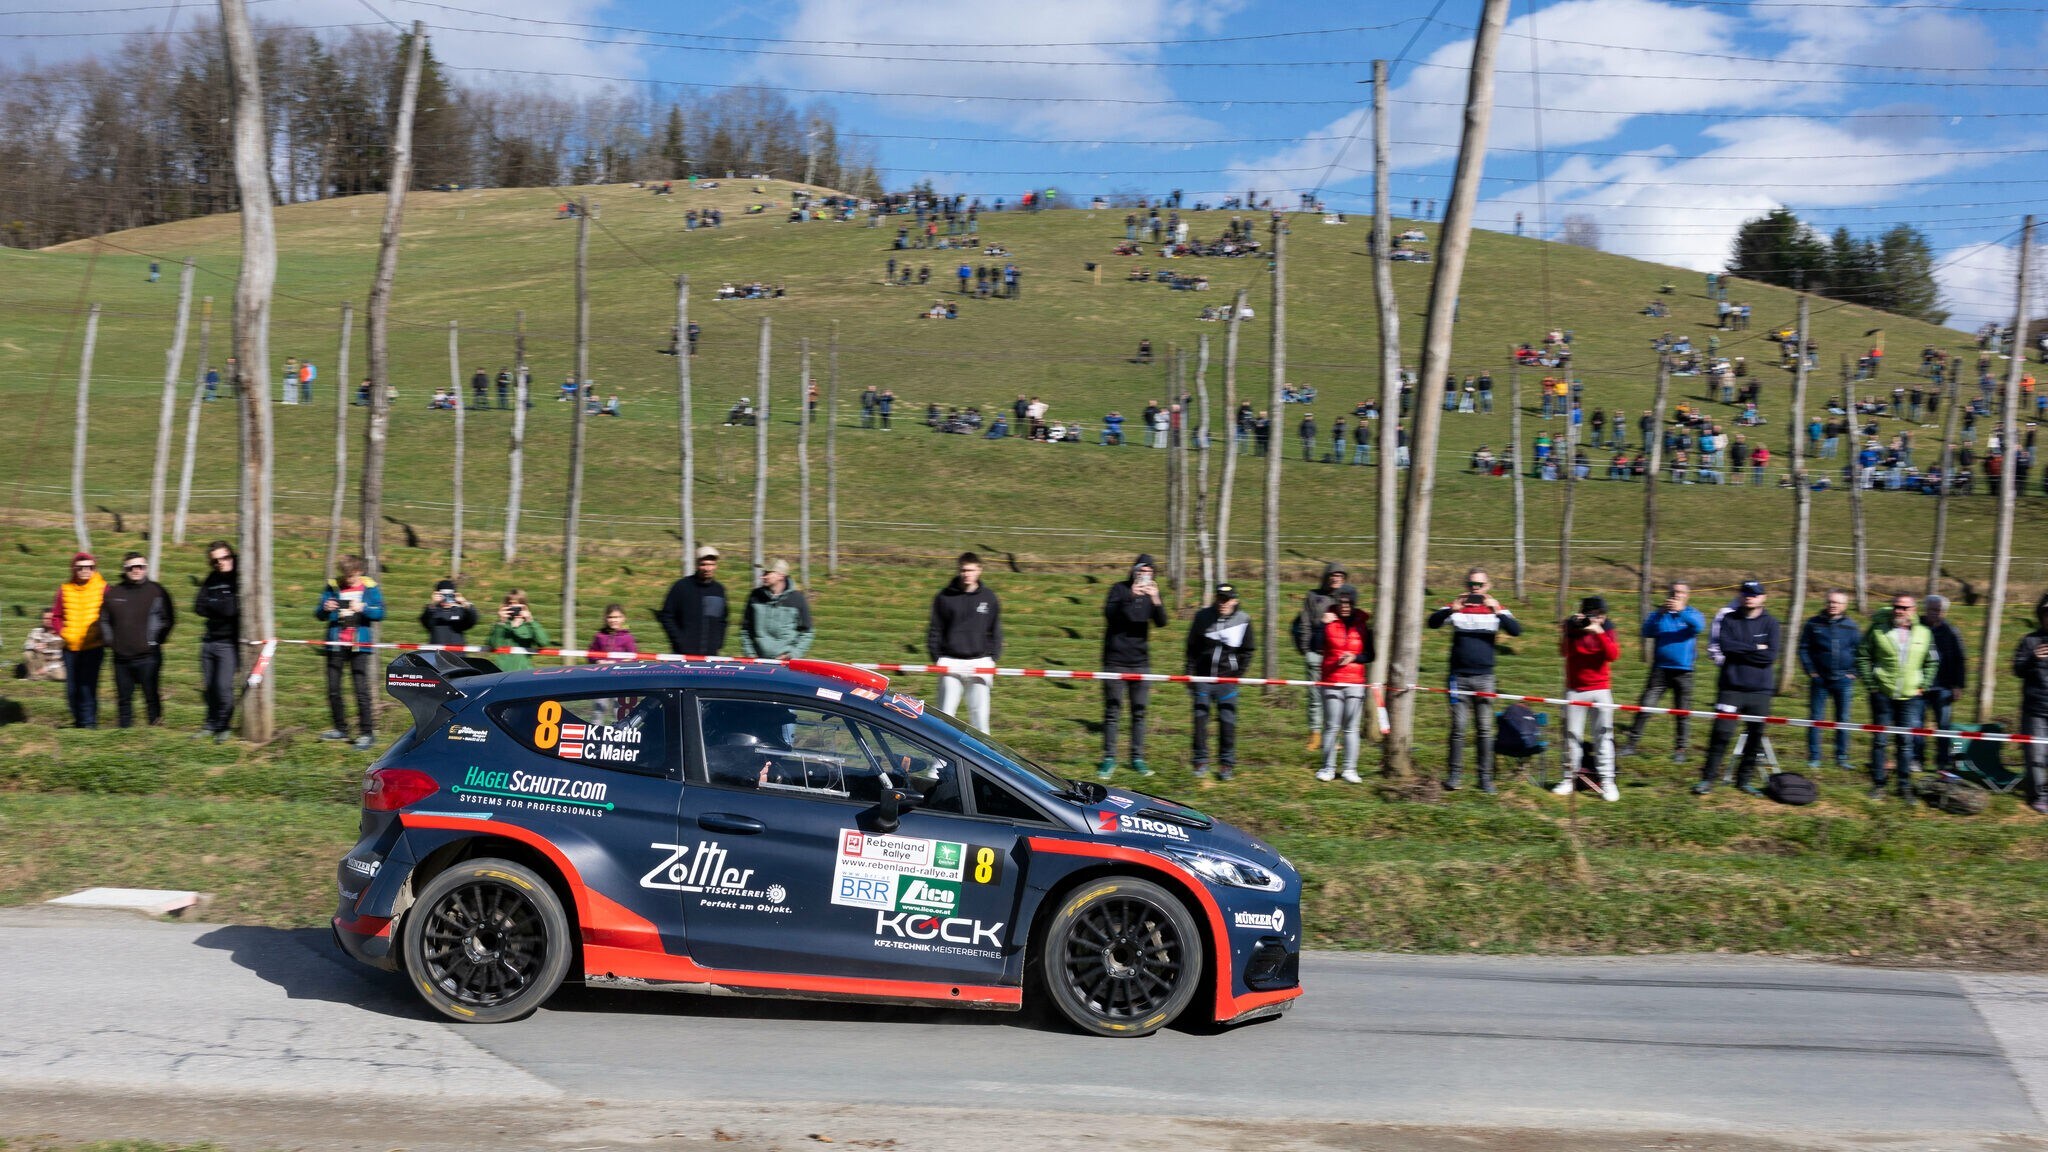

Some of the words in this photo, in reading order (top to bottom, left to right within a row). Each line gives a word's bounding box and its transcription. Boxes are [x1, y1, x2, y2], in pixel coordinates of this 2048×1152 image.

[534, 700, 562, 749] 8
[586, 724, 601, 741] K.
[602, 725, 642, 744] Raith
[584, 743, 597, 760] C.
[600, 743, 640, 762] Maier
[460, 794, 502, 806] SYSTEMS
[506, 799, 524, 809] FOR
[527, 801, 603, 818] PROFESSIONALS
[1120, 814, 1189, 838] STROBL
[866, 837, 925, 853] Rebenland
[882, 848, 911, 860] Rallye
[841, 858, 958, 879] www.rebenland-rallye.at
[974, 847, 995, 884] 8
[705, 886, 764, 898] TISCHLEREI
[840, 878, 889, 902] BRR
[699, 899, 737, 910] Perfekt
[739, 903, 754, 911] am
[757, 903, 793, 914] Objekt.
[1234, 910, 1272, 926] MÜNZER
[874, 939, 931, 952] KFZ-TECHNIK
[932, 945, 1002, 960] MEISTERBETRIEB
